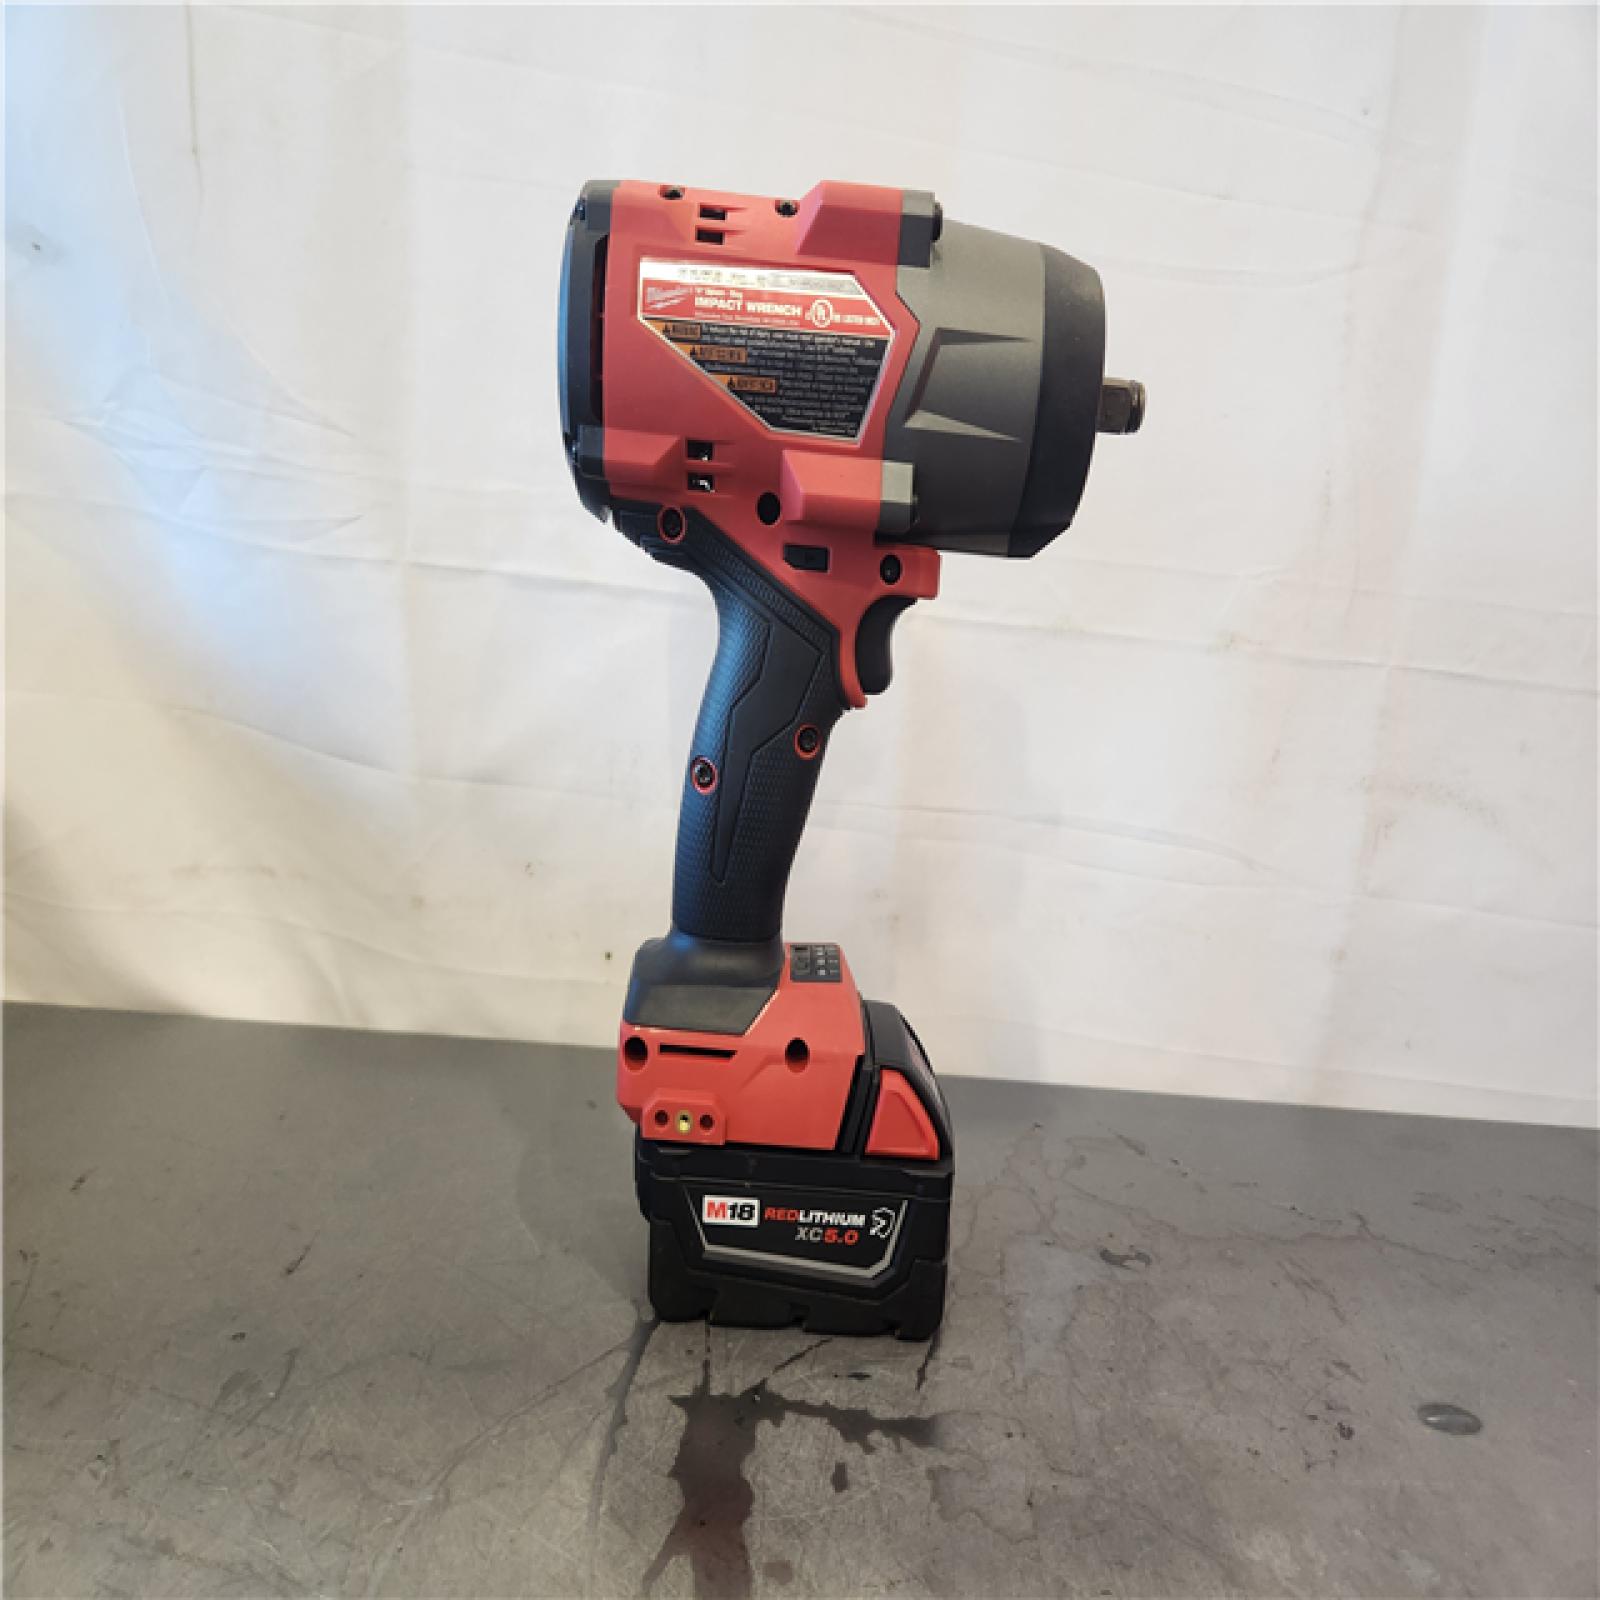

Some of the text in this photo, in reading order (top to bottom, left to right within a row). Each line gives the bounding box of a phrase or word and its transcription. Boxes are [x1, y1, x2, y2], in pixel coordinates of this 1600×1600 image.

[695, 297, 742, 311] IMPACT
[747, 302, 803, 317] WRENCH
[706, 1200, 866, 1226] M18 REDLITHIUM
